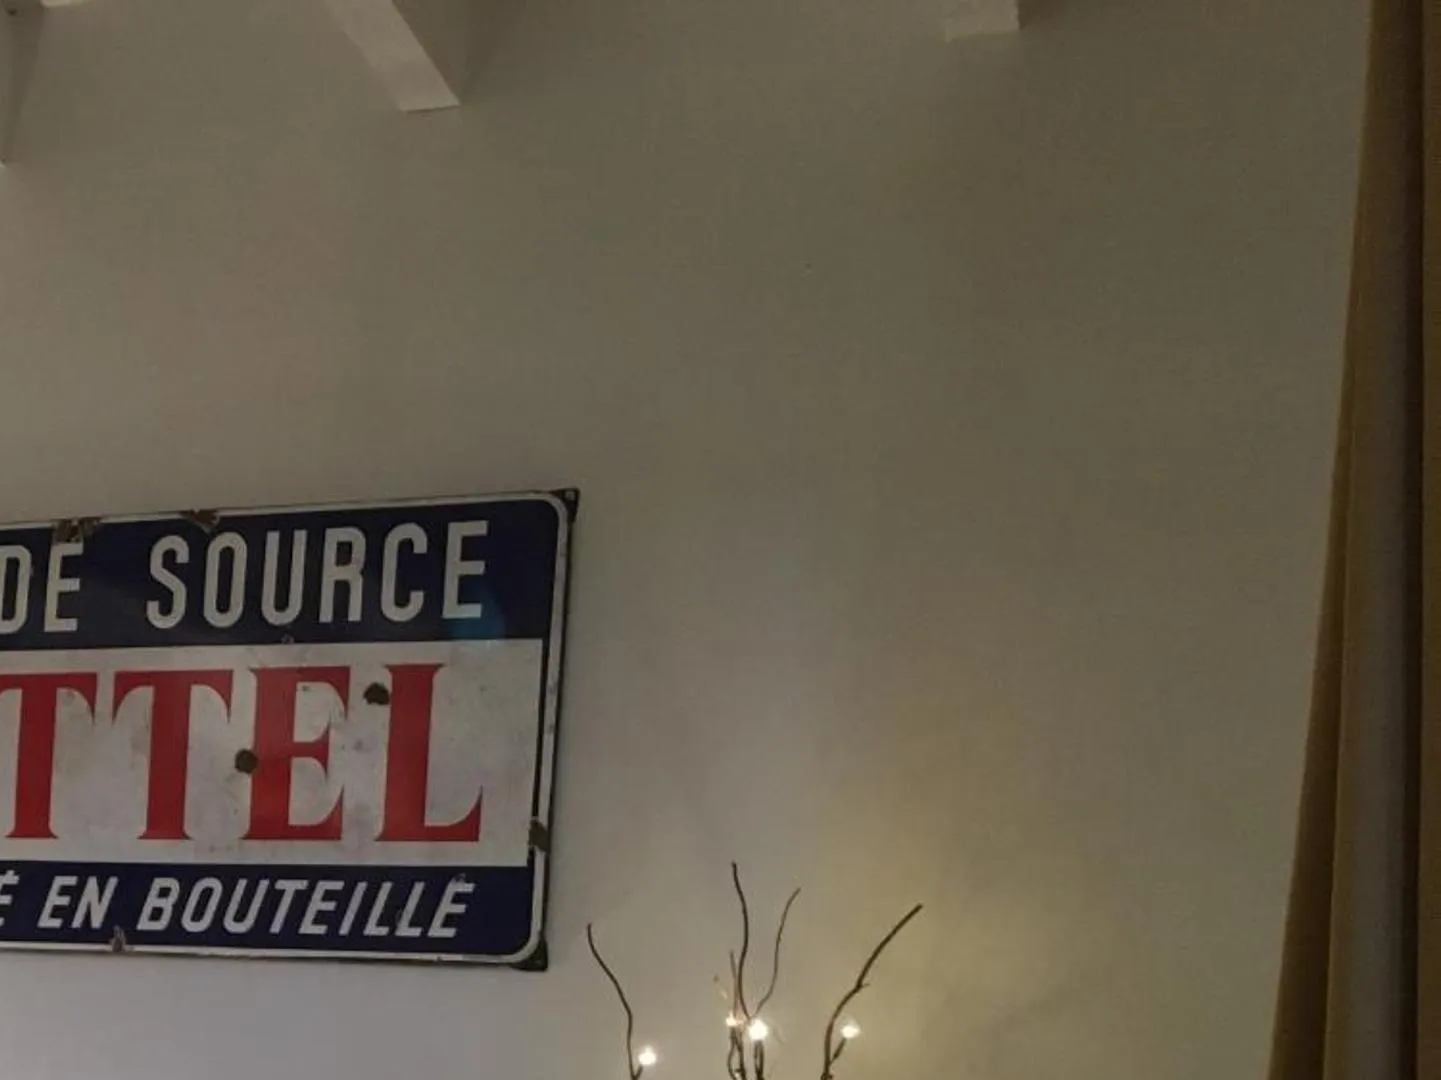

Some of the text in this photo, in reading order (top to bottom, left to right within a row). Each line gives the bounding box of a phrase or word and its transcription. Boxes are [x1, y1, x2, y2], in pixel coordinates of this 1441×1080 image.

[146, 520, 489, 629] SOURCE
[37, 875, 118, 932] EN
[137, 878, 475, 939] BOUTEILLE
